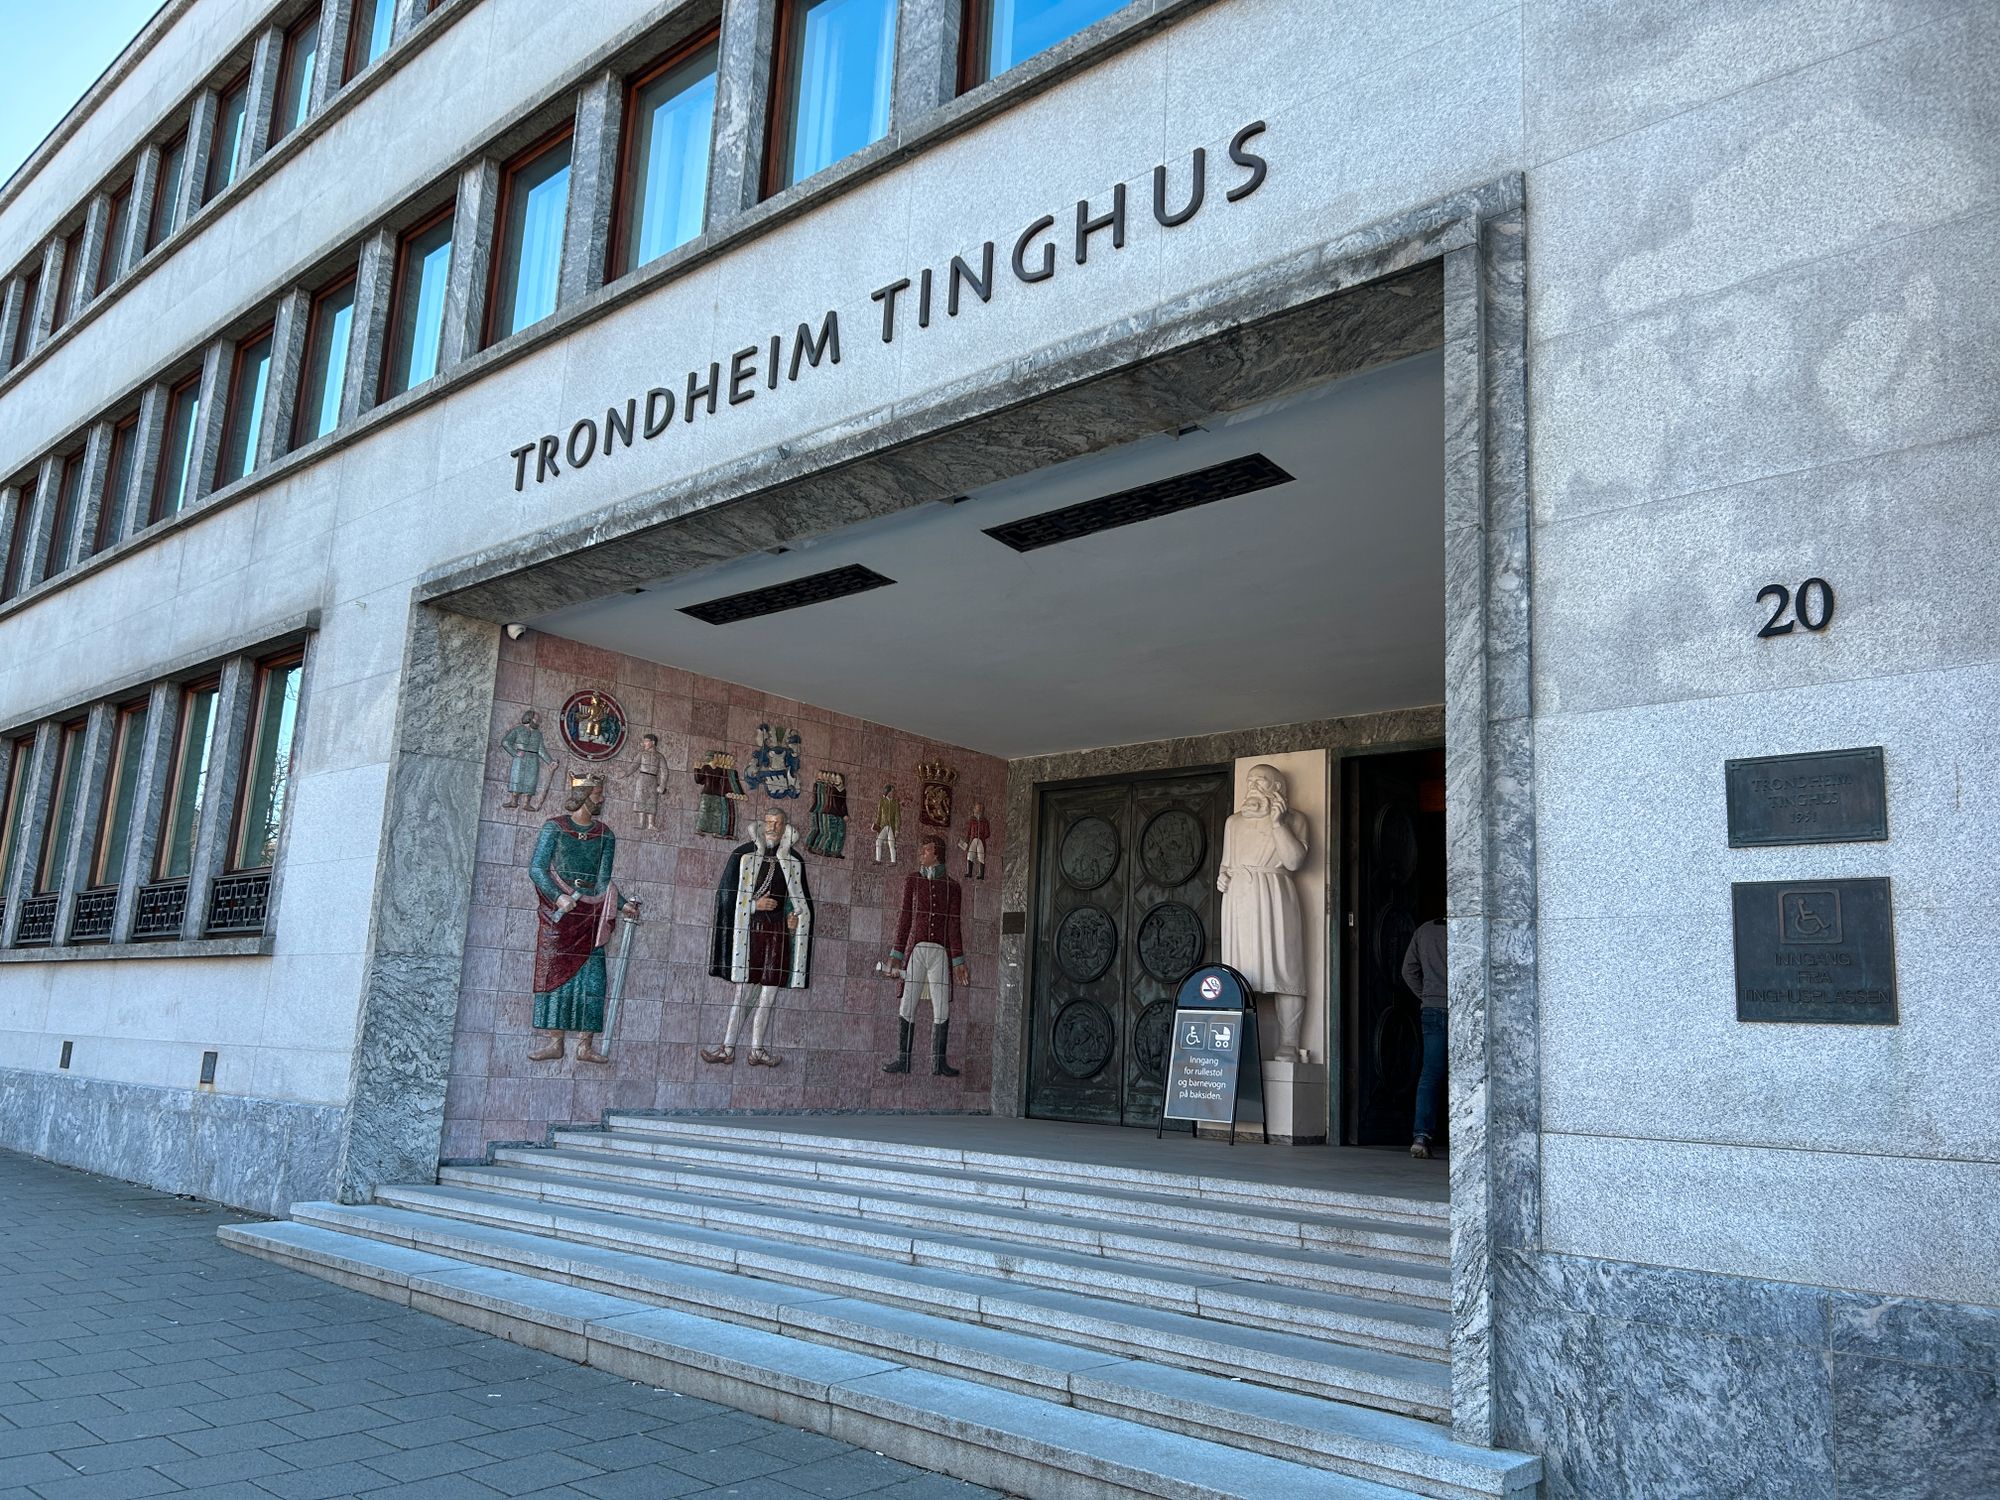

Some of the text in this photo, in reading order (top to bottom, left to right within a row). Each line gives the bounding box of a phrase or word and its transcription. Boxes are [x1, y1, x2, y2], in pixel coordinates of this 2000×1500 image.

[510, 120, 1267, 492] TRONDHEIM TINGHUS
[1756, 577, 1835, 638] 20
[1752, 774, 1853, 792] TRONDHEIM
[1768, 791, 1840, 809] TINGHUS
[1775, 951, 1852, 966] INNGANG
[1798, 970, 1833, 984] FRA
[1740, 987, 1891, 1004] TINGHUSPLASSEN
[1189, 1055, 1219, 1067] Inngang
[1184, 1066, 1223, 1077] for rullestol
[1178, 1079, 1226, 1090] og barnevogn
[1179, 1090, 1222, 1100] på baksiden.
